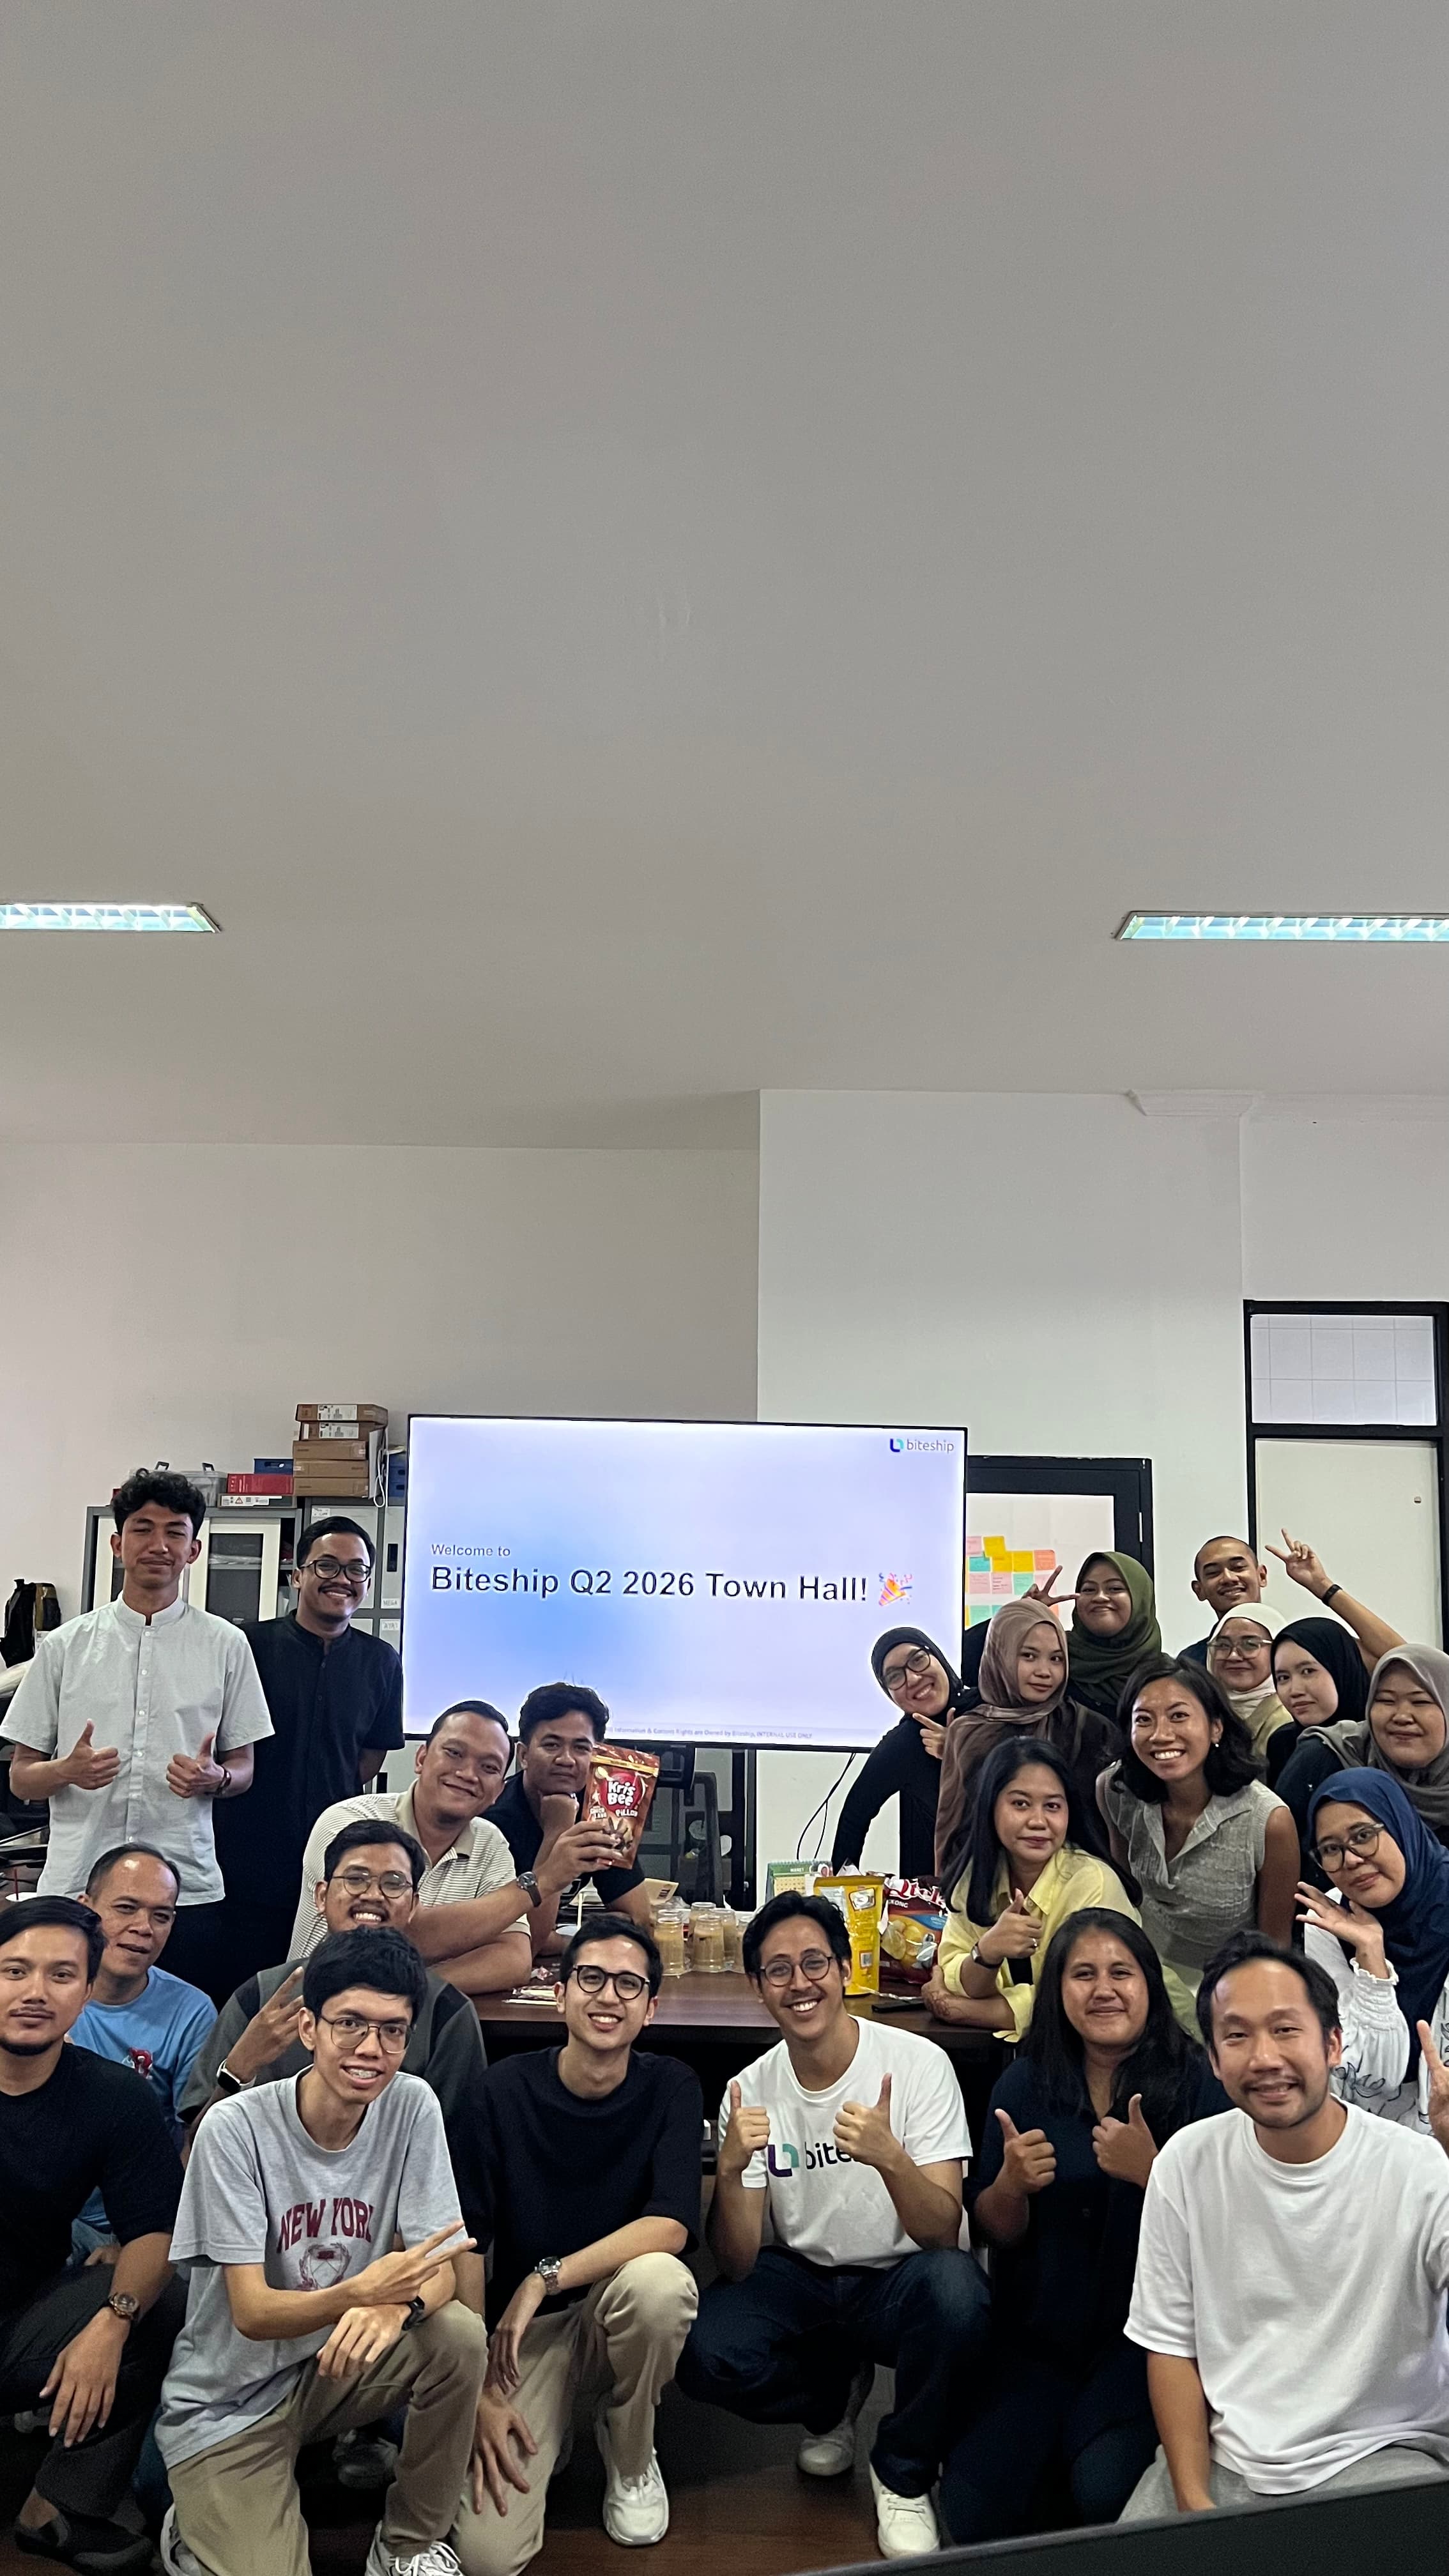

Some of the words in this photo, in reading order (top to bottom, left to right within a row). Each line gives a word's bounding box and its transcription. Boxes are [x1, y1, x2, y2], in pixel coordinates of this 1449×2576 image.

[907, 1438, 954, 1453] biteship
[431, 1544, 493, 1556] Welcome
[498, 1545, 510, 1556] to
[432, 1567, 559, 1598] Biteship
[571, 1569, 611, 1595] Q2
[622, 1571, 694, 1596] 2026
[705, 1573, 786, 1598] Town
[799, 1575, 867, 1601] Hall!
[608, 1781, 636, 1797] Kris
[607, 1793, 634, 1806] Bee
[804, 2141, 852, 2170] bite
[276, 2198, 326, 2253] NEW
